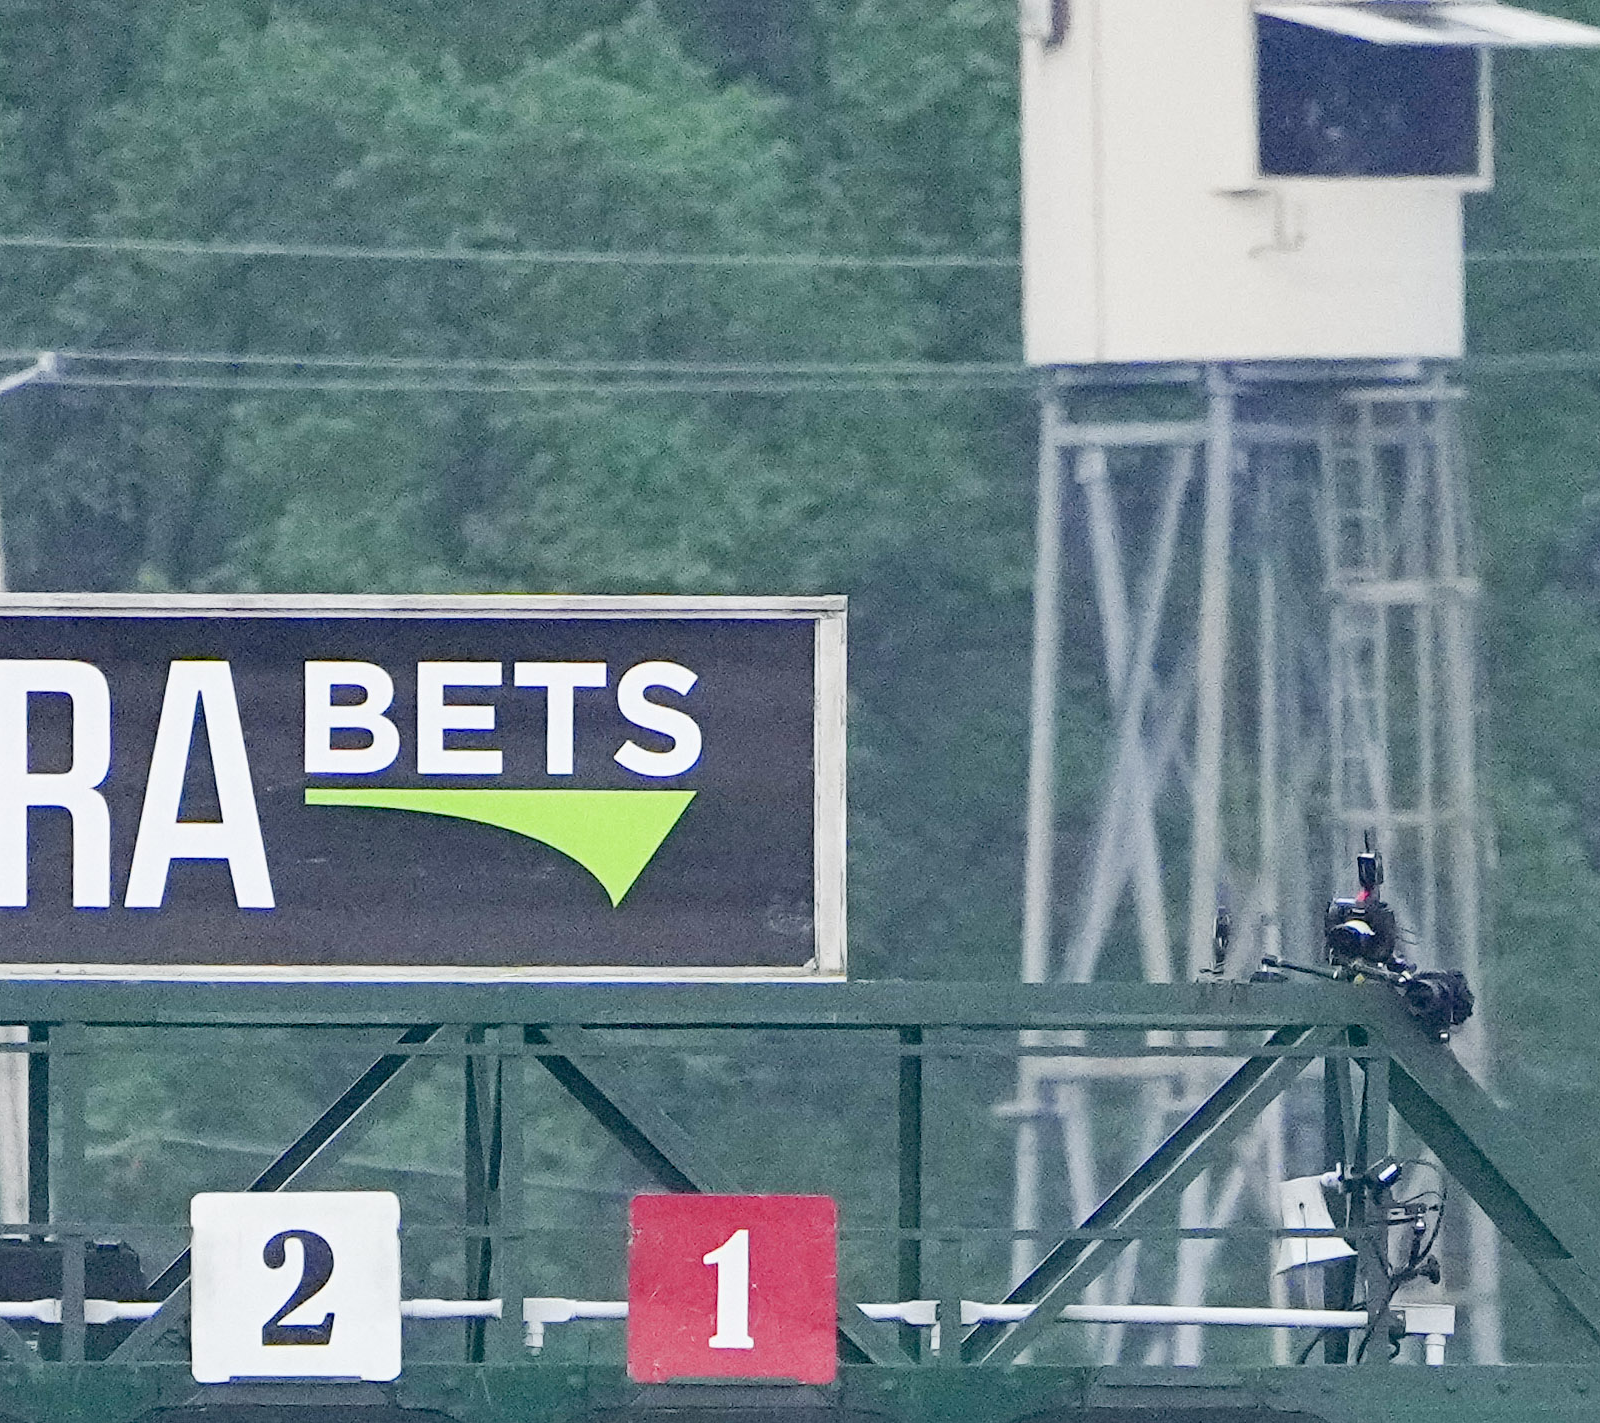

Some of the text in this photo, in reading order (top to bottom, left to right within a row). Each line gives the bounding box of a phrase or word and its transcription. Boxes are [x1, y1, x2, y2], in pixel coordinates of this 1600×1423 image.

[304, 660, 702, 777] BETS
[262, 1229, 336, 1346] 2
[702, 1229, 755, 1350] 1
